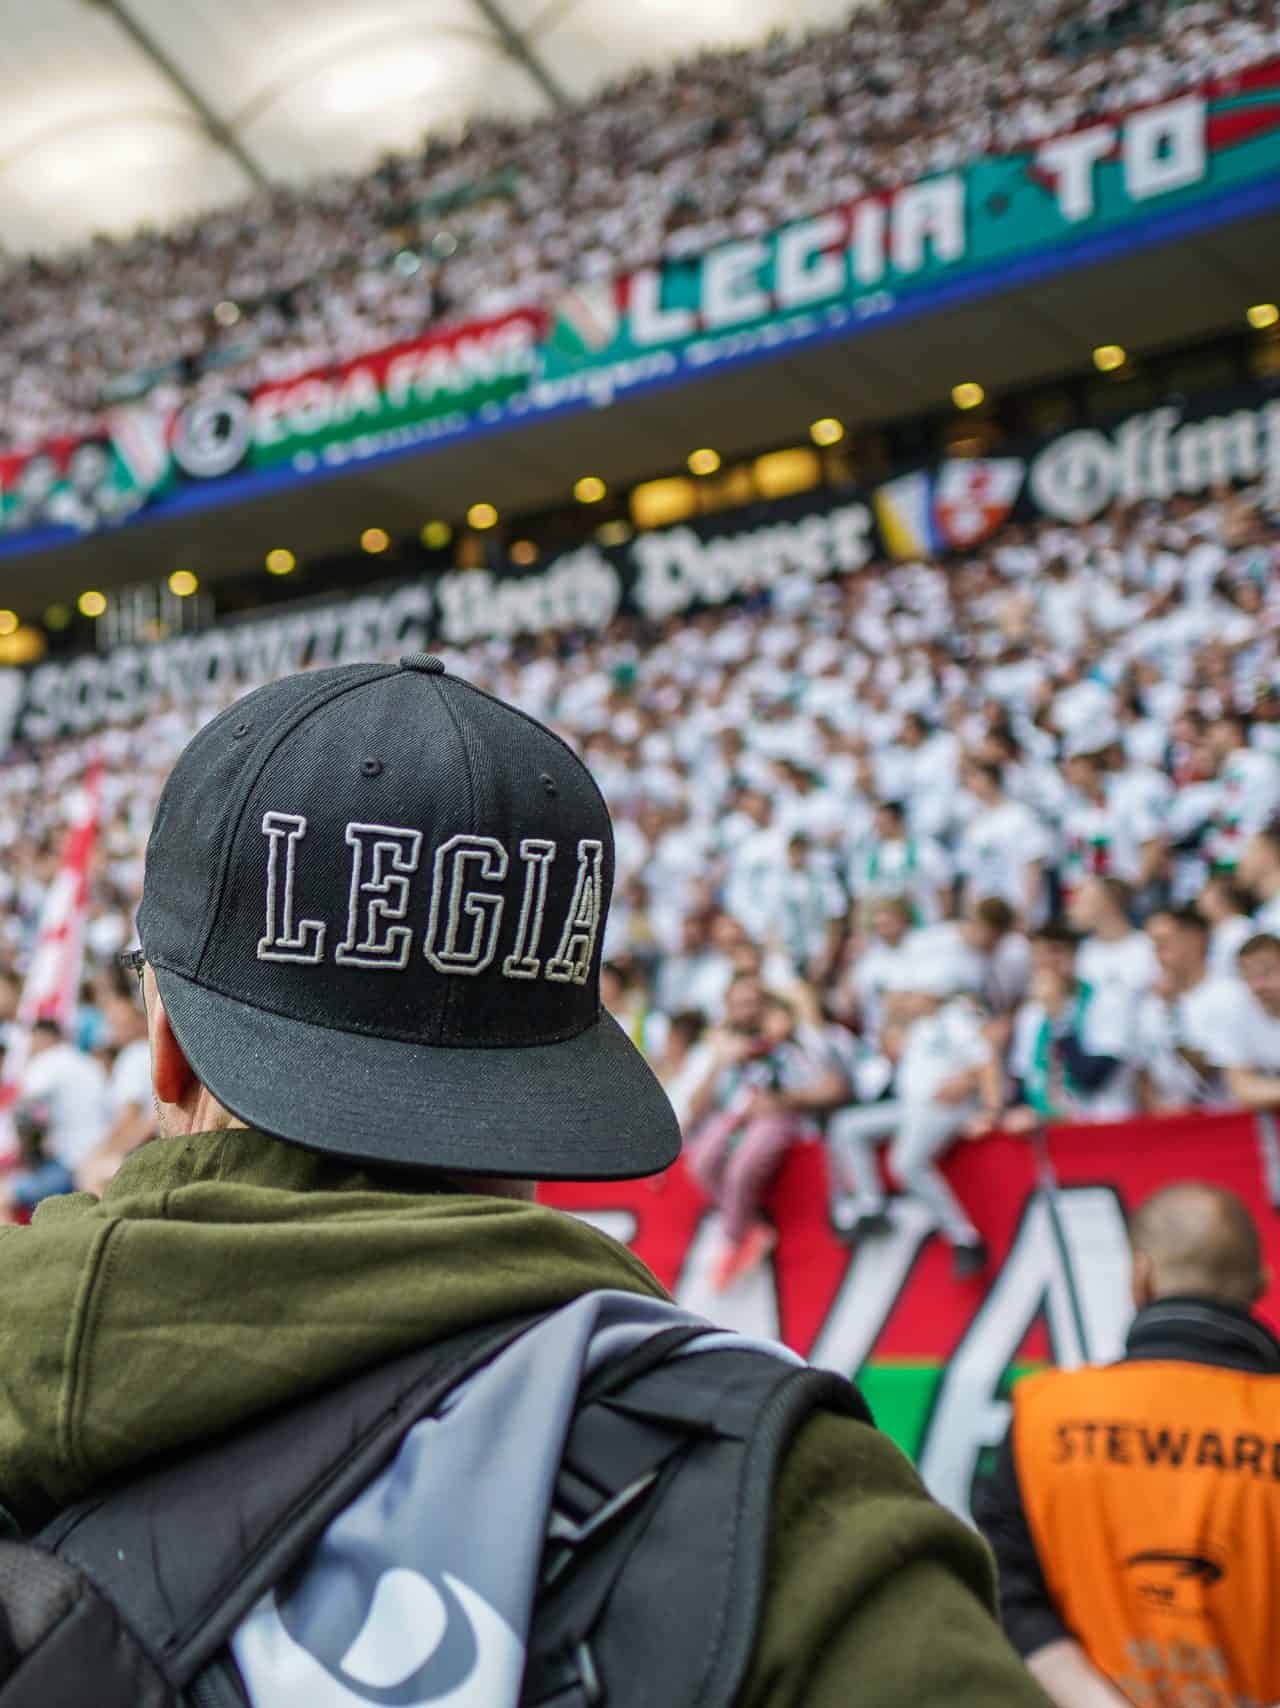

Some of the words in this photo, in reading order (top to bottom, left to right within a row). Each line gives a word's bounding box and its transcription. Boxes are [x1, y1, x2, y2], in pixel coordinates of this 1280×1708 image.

[628, 172, 964, 343] LEGIA
[1037, 96, 1209, 222] TO
[256, 811, 604, 985] LEGIA
